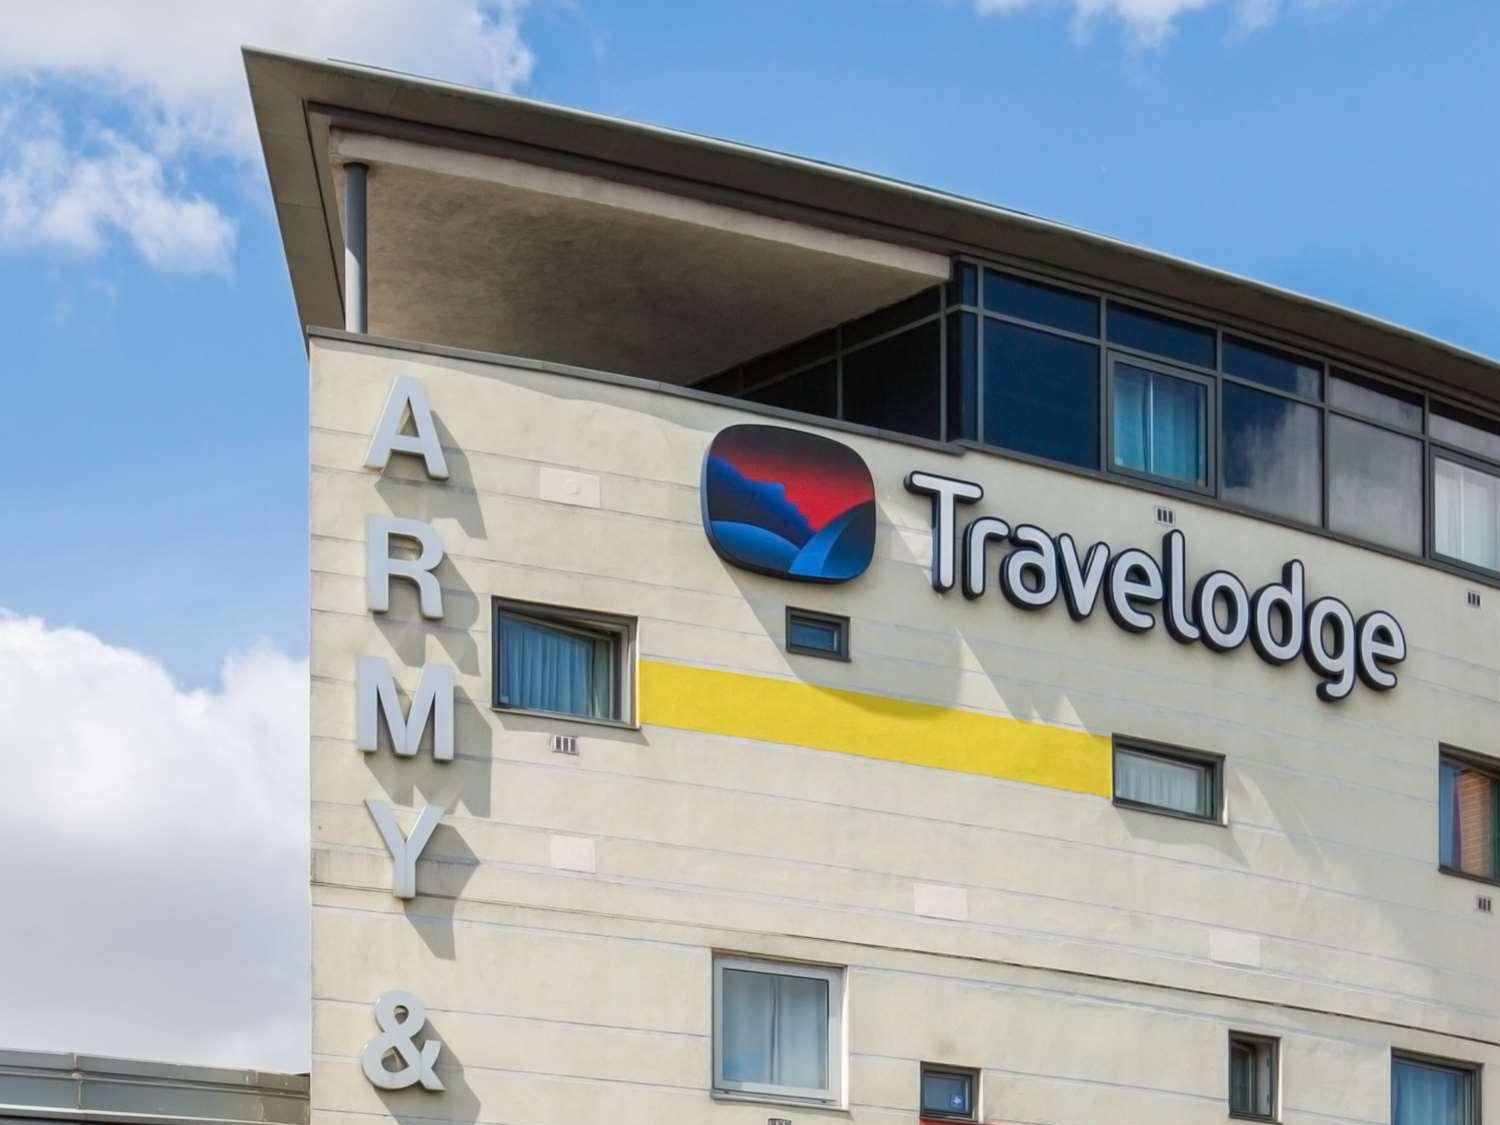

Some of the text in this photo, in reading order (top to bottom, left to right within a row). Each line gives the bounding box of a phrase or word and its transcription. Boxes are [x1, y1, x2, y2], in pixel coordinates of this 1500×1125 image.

[355, 374, 456, 900] ARMY
[904, 470, 1407, 702] Travelodge
[361, 988, 447, 1094] &
